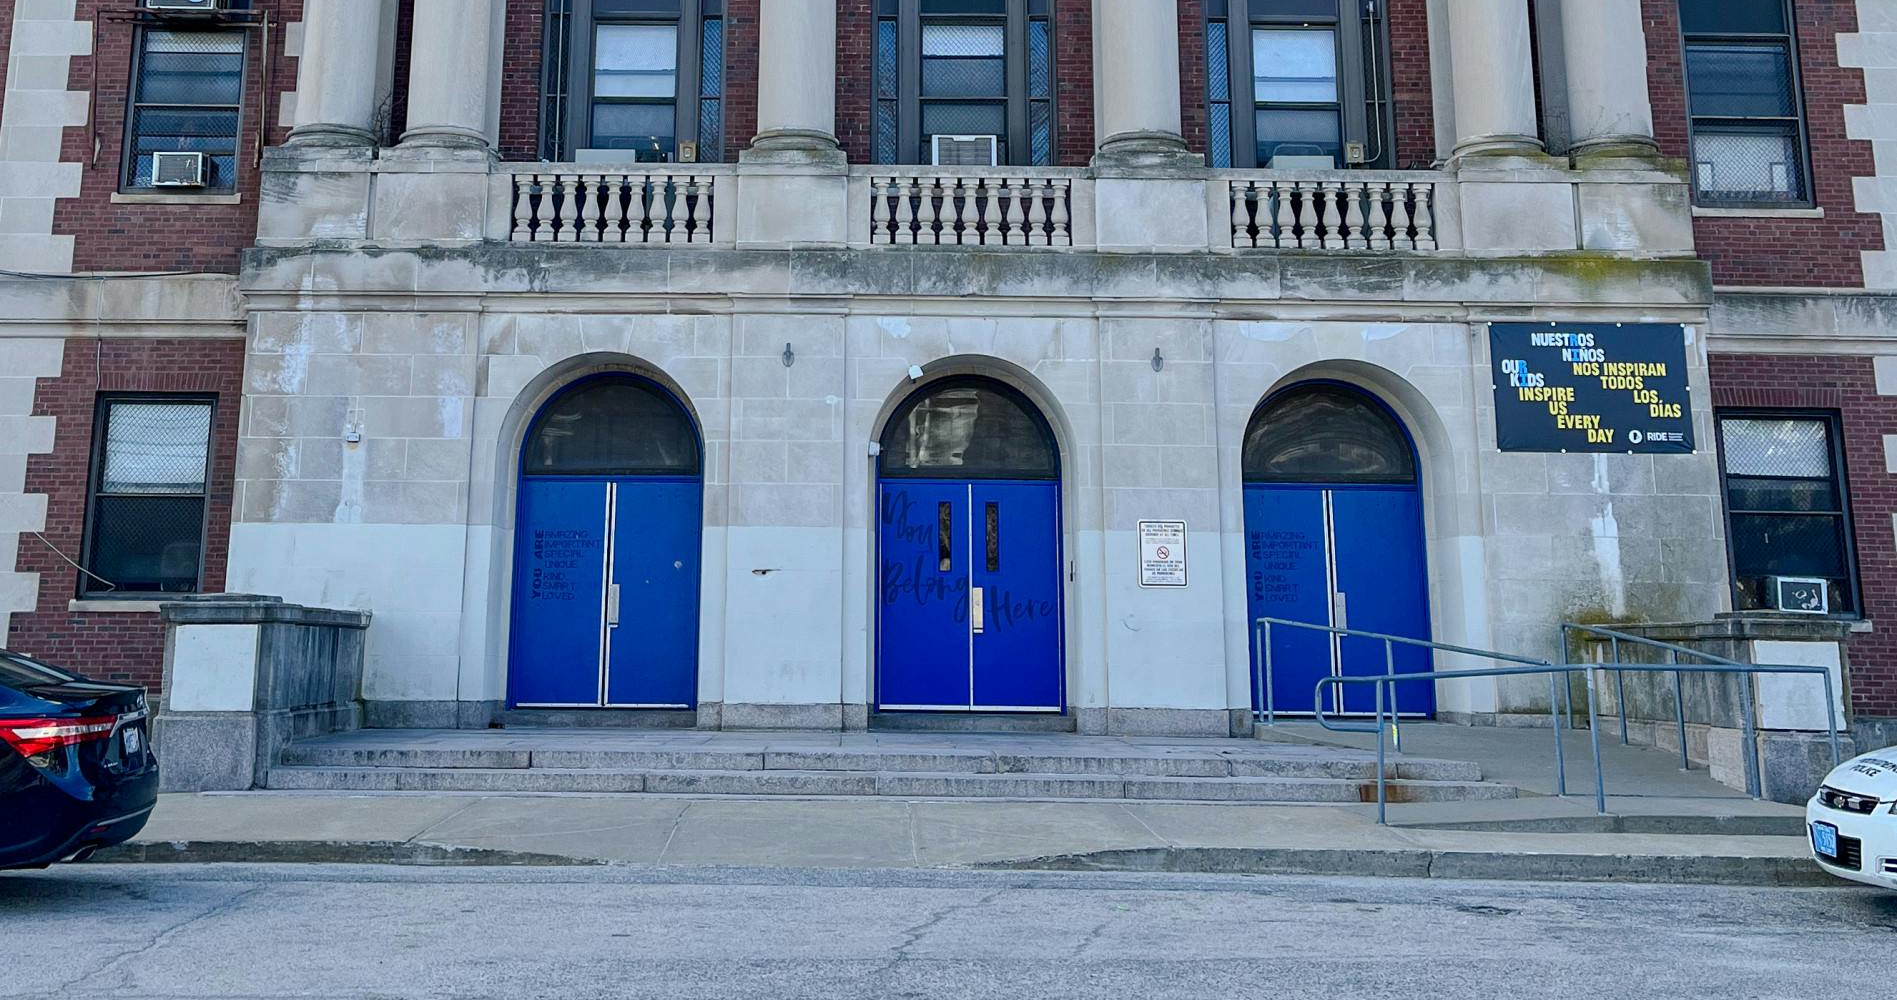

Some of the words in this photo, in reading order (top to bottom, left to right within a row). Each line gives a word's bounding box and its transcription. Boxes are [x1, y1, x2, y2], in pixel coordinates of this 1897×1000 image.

[1531, 333, 1595, 347] NUESTROS
[1562, 346, 1605, 362] NIÑOS
[1501, 360, 1528, 374] OUR
[1573, 362, 1600, 376] NOS
[1603, 363, 1666, 377] INSPIRAN
[1510, 373, 1545, 387] KIDS
[1600, 376, 1644, 390] TODOS
[1519, 387, 1575, 401] INSPIRE
[1633, 390, 1659, 404] LOS
[1549, 401, 1568, 415] US
[1650, 400, 1681, 418] DÍAS
[1557, 415, 1600, 429] EVERY
[1587, 429, 1614, 443] DAY
[1647, 432, 1668, 441] RIDE
[534, 529, 544, 559] ARE
[1251, 530, 1261, 560] ARE
[532, 568, 542, 599] YOU
[1254, 571, 1264, 601] YOU
[883, 556, 968, 623] Belong
[985, 585, 1053, 632] Here
[1849, 764, 1881, 777] POLICE
